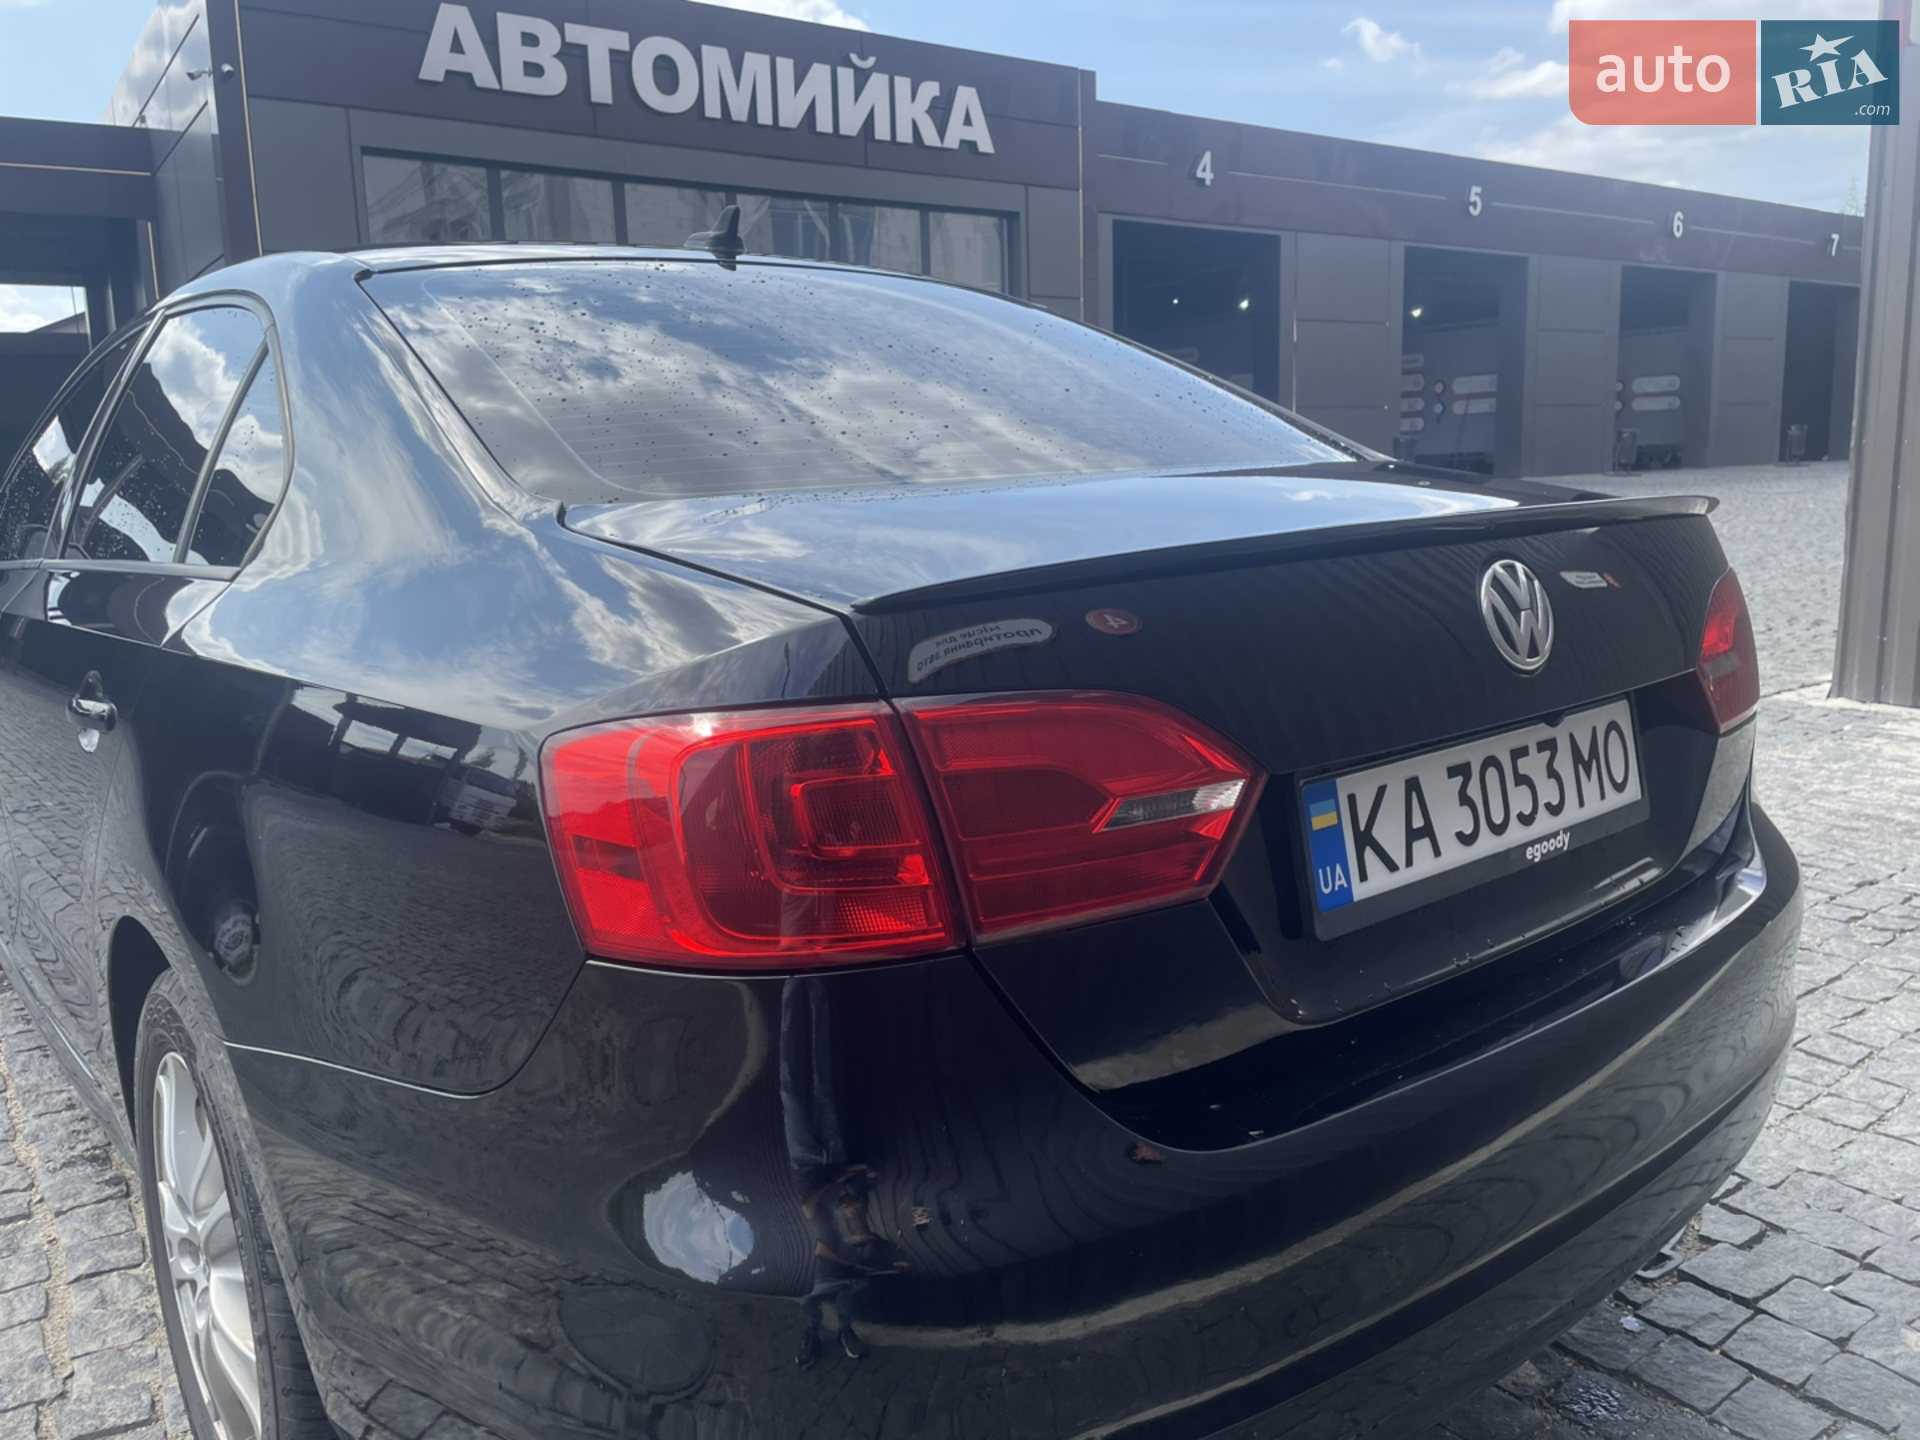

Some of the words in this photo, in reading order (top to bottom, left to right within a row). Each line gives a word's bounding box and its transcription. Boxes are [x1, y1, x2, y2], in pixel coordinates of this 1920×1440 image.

[418, 2, 995, 154] АВТОМИЙКА
[1195, 150, 1214, 186] 4
[1468, 185, 1482, 217] 5
[1673, 210, 1684, 239] 6
[1830, 233, 1840, 257] 7
[1347, 774, 1442, 883] KA
[1446, 737, 1567, 847] 3053
[1568, 719, 1631, 809] MO
[1525, 830, 1572, 863] egoody
[1317, 862, 1349, 895] UA
